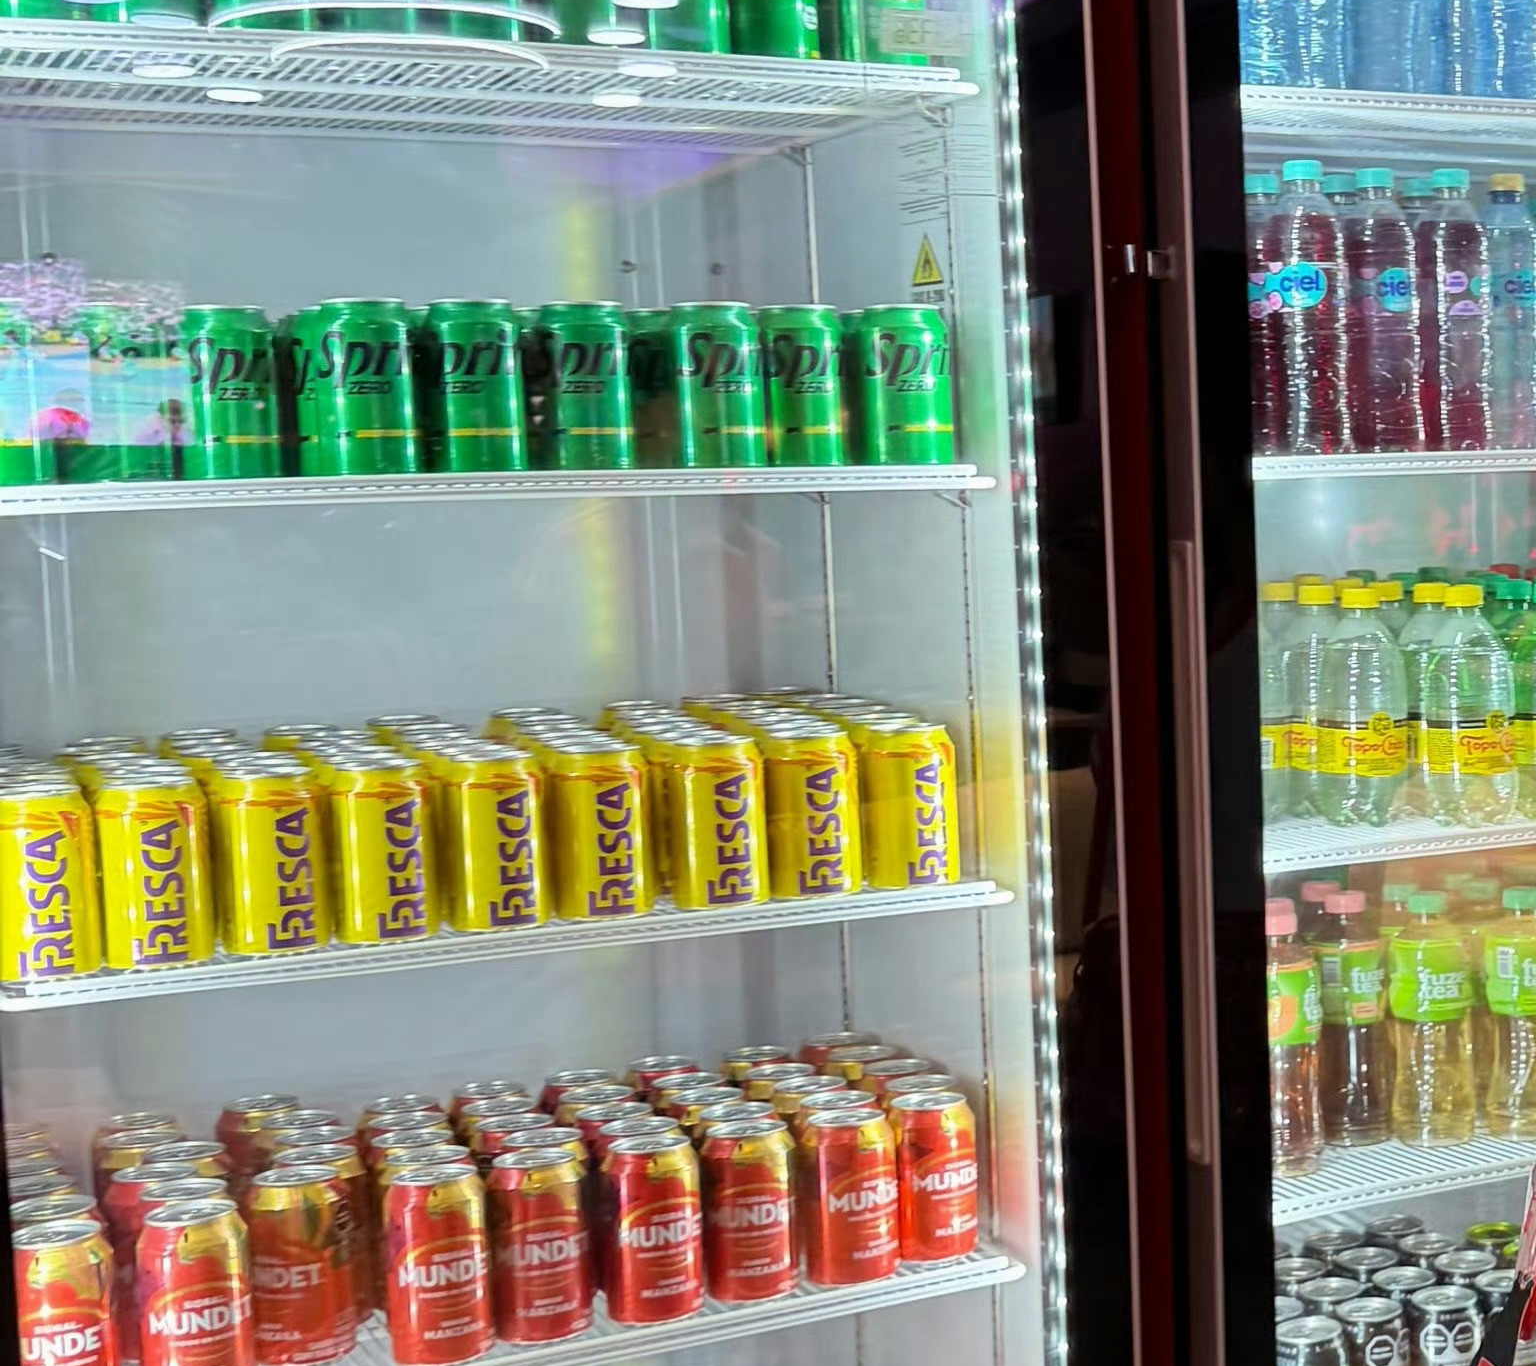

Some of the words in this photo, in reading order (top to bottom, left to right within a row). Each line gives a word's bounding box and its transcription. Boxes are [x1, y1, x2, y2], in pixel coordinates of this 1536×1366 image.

[1279, 270, 1321, 294] ciel
[133, 819, 190, 966] FRESCA
[268, 806, 317, 952] FRESCA
[379, 797, 427, 939] FRESCA
[489, 789, 537, 927] FRESCA
[588, 780, 636, 917] FRESCA
[707, 773, 753, 906] FRESCA
[799, 766, 844, 896] FRESCA
[20, 829, 75, 978] FRESCA
